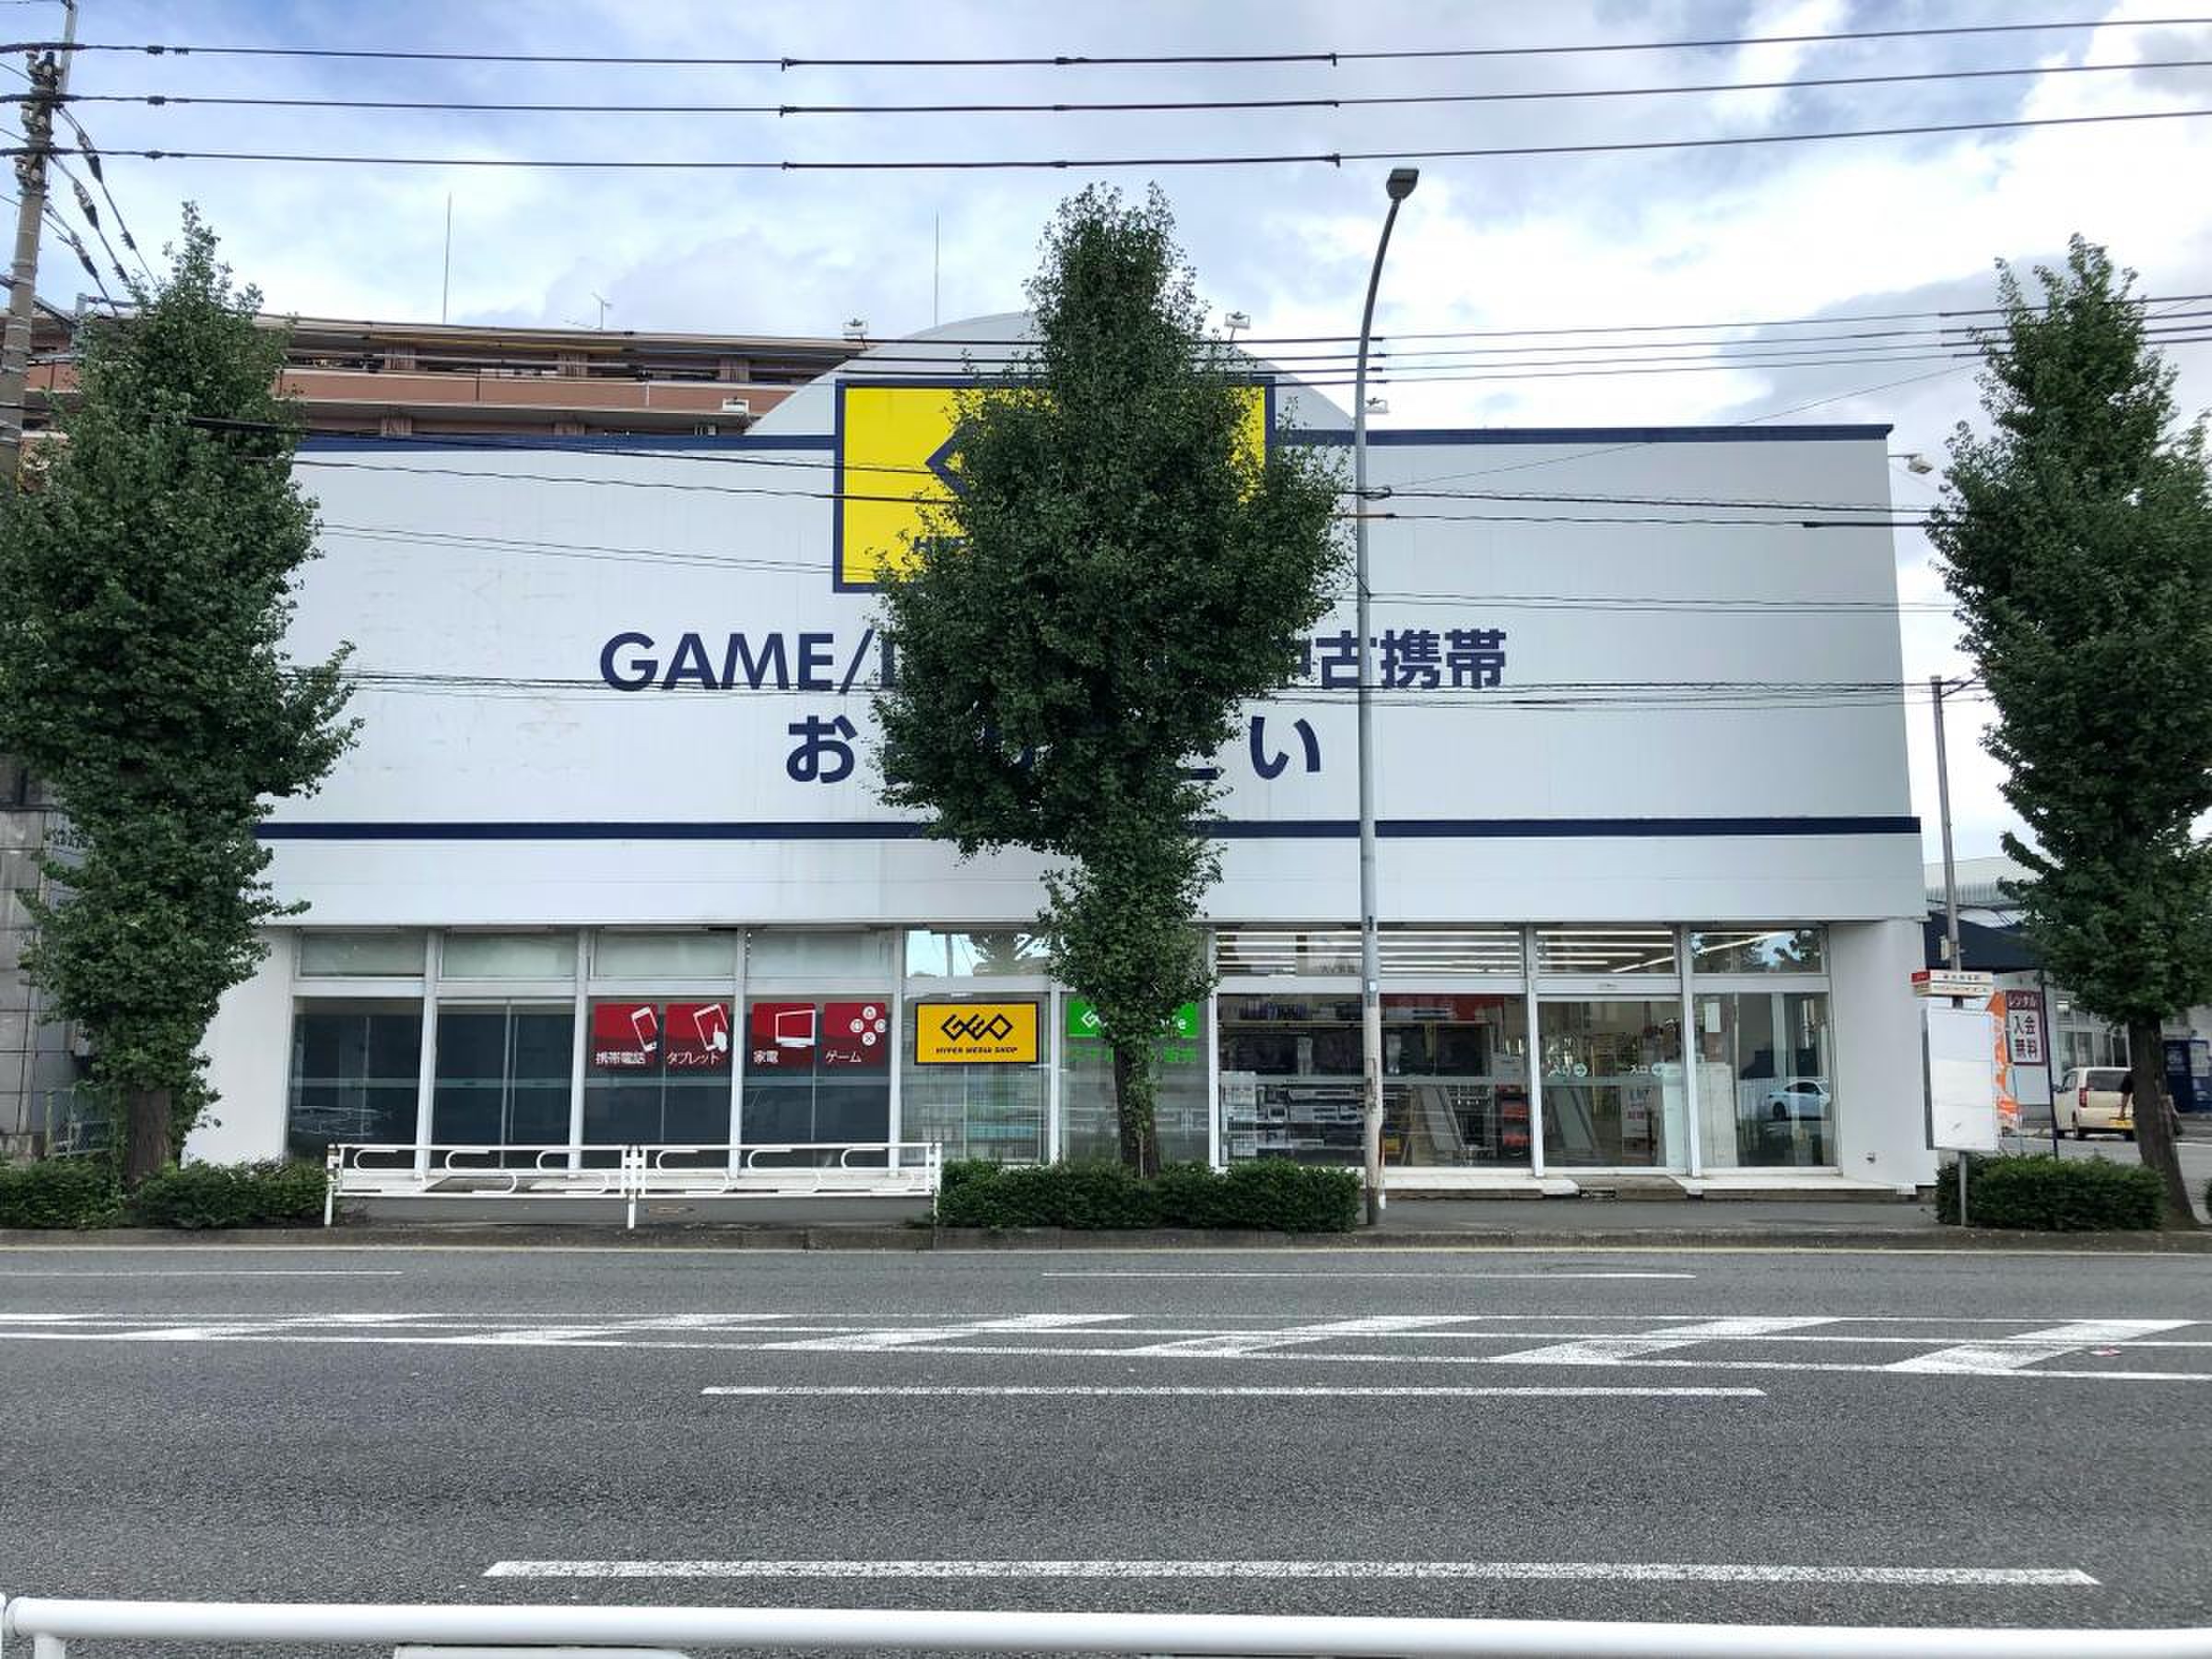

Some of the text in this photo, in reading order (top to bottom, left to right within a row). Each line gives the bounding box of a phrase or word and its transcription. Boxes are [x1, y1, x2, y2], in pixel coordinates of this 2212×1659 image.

[941, 1013, 1013, 1041] GEO
[595, 1051, 646, 1065] 携帯電話
[666, 1051, 720, 1065] タブレット
[752, 1050, 779, 1064] 家電
[825, 1050, 862, 1064] ゲーム
